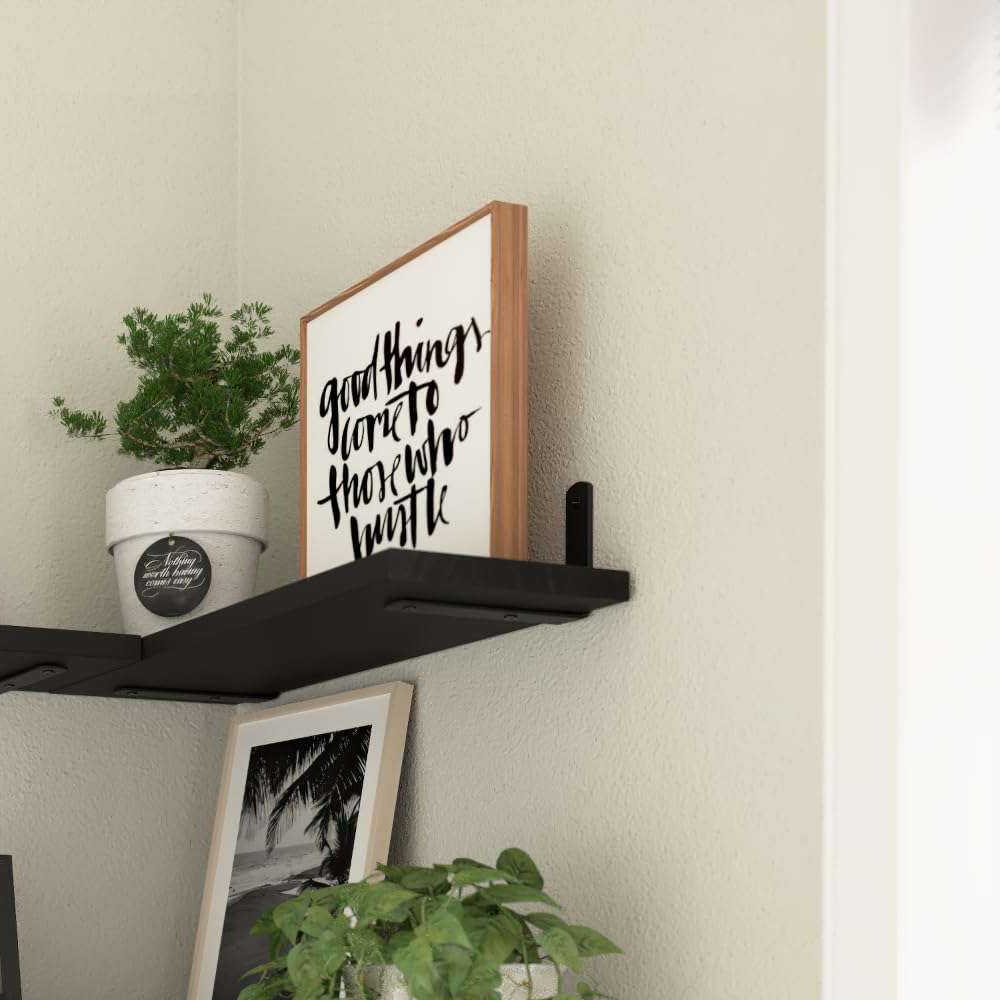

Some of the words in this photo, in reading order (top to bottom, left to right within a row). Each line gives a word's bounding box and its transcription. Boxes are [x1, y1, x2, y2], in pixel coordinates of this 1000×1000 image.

[320, 334, 380, 455] good
[379, 317, 491, 394] things
[341, 402, 402, 461] come
[385, 379, 440, 436] to
[317, 454, 402, 529] those
[403, 407, 483, 483] who
[350, 477, 450, 562] hustle
